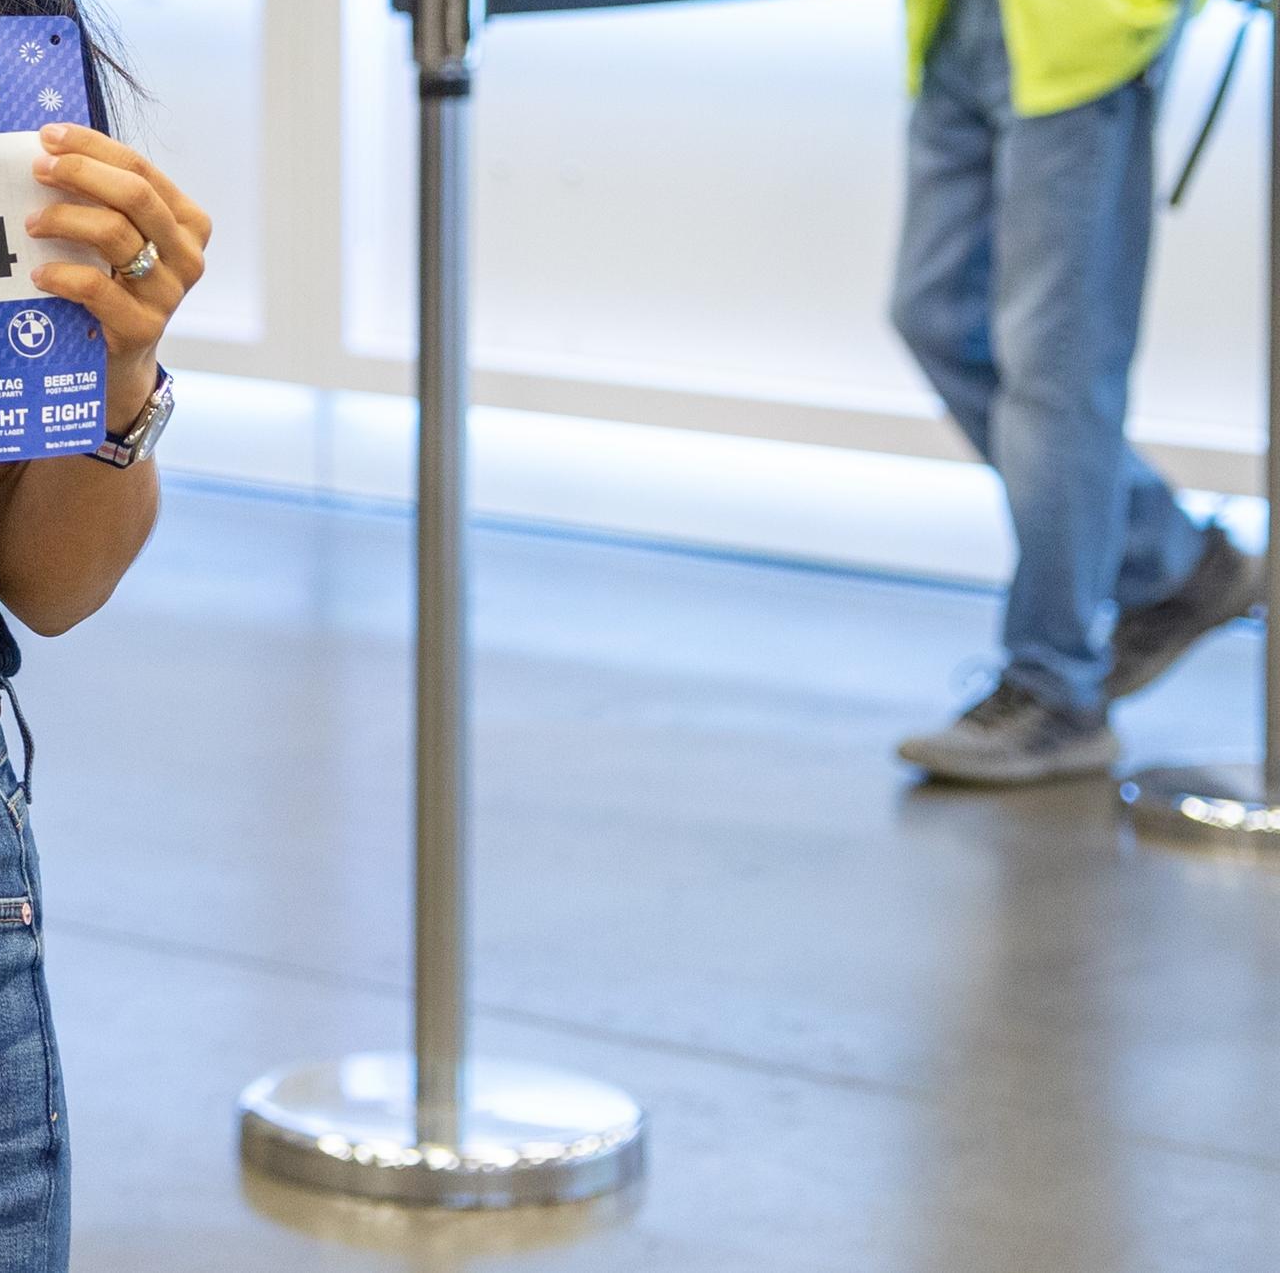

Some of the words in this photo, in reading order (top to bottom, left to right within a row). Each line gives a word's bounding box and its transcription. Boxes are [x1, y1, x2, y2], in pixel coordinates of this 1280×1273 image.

[44, 374, 74, 387] BEER
[75, 371, 97, 383] TAG
[42, 401, 101, 423] EIGHT
[62, 423, 78, 431] LIGHT
